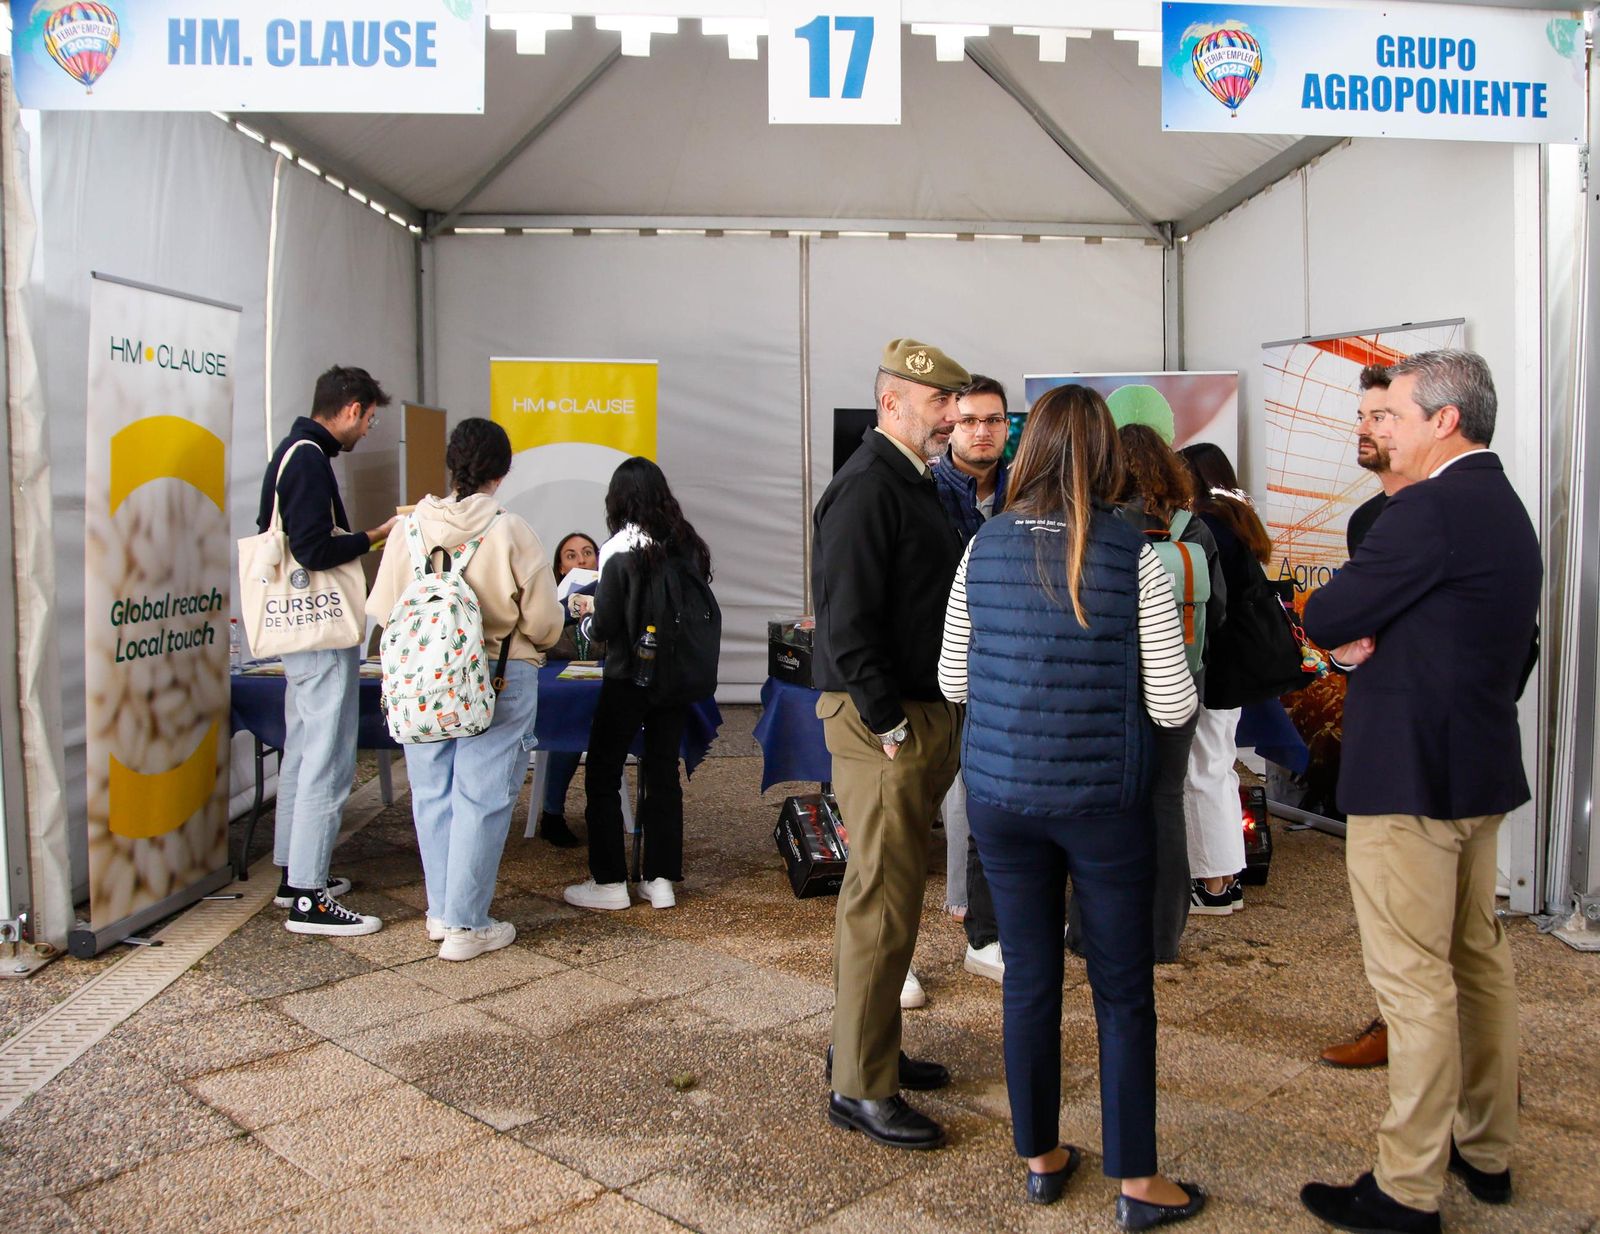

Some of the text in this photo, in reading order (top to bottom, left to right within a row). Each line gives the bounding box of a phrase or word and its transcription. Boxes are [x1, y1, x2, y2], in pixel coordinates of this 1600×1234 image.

[67, 38, 102, 52] 2025
[168, 17, 437, 67] HM. CLAUSE
[794, 15, 875, 99] 17
[1203, 52, 1223, 67] FERIA
[1226, 50, 1254, 64] EMPLEO
[1375, 34, 1476, 72] GRUPO
[1214, 64, 1246, 78] 2025
[1301, 73, 1547, 118] AGROPONIENTE
[1278, 557, 1342, 593] Agro
[110, 587, 222, 627] Global reach
[265, 591, 341, 614] CURSOS
[265, 617, 282, 628] DE
[286, 607, 344, 627] VERANO
[115, 621, 215, 663] Local touch
